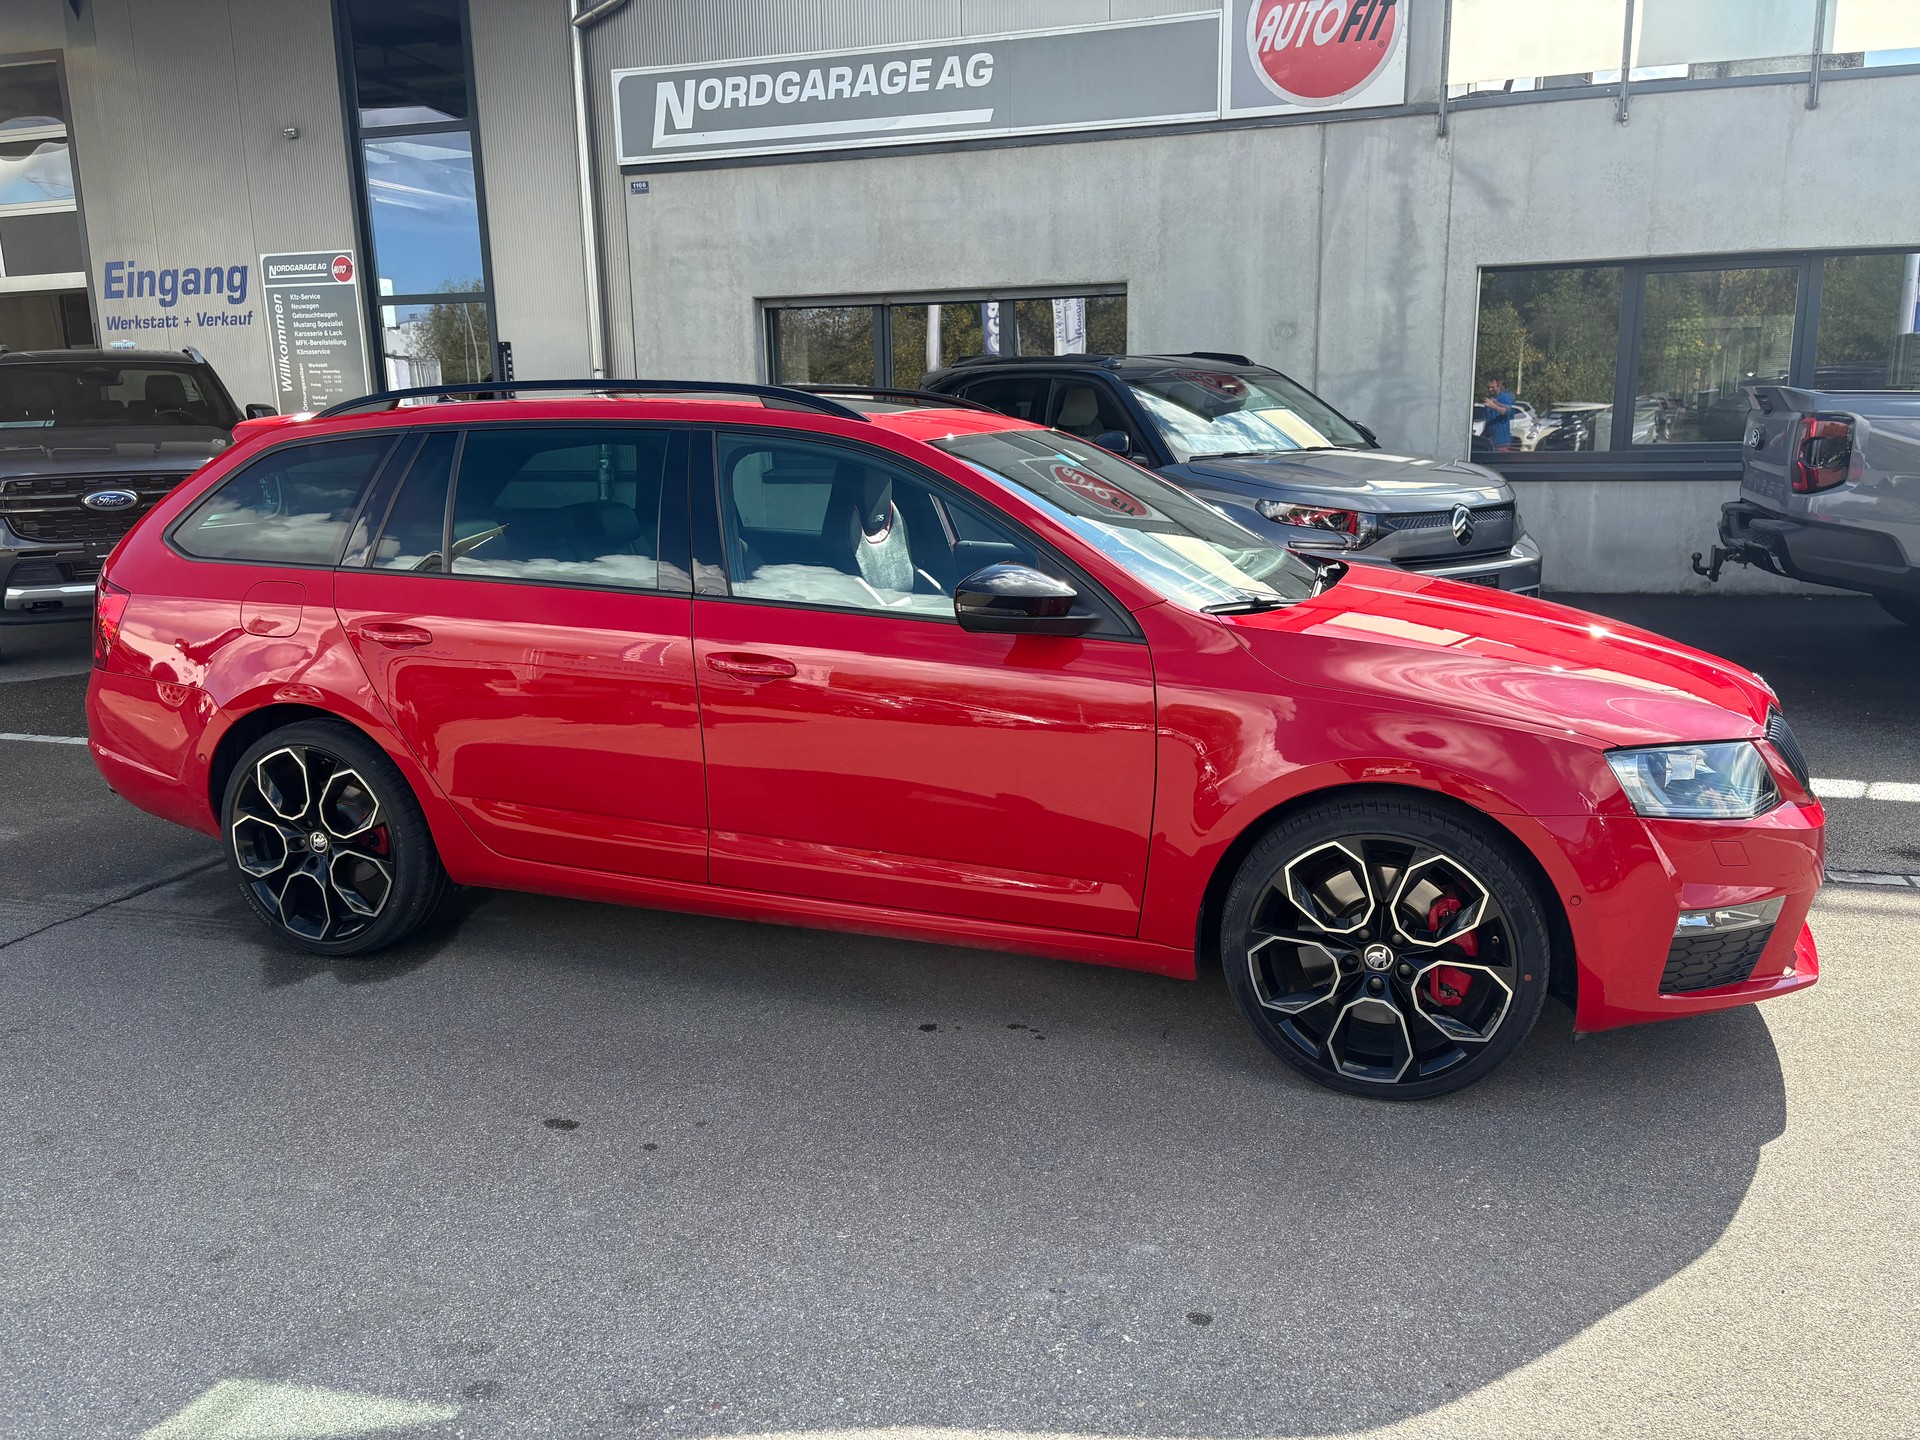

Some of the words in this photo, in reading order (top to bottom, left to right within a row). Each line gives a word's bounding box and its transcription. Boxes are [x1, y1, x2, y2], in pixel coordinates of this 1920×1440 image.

[1256, 0, 1398, 52] AUTOFIT
[653, 58, 932, 130] NORDGARAGE
[936, 53, 994, 90] AG
[268, 263, 317, 276] NORDGARAGE
[317, 262, 327, 270] AG
[104, 260, 249, 308] Eingang
[106, 315, 179, 331] Werkstatt
[184, 317, 192, 327] +
[196, 310, 253, 327] Verkauf
[294, 321, 317, 329] Mustang
[317, 320, 344, 328] Spezialist
[273, 293, 293, 392] Willkommen
[296, 339, 347, 347] MFK-Bereitstellung
[297, 348, 331, 356] Klimaservice
[97, 495, 125, 506] Ford
[1457, 847, 1518, 910] NEXEN
